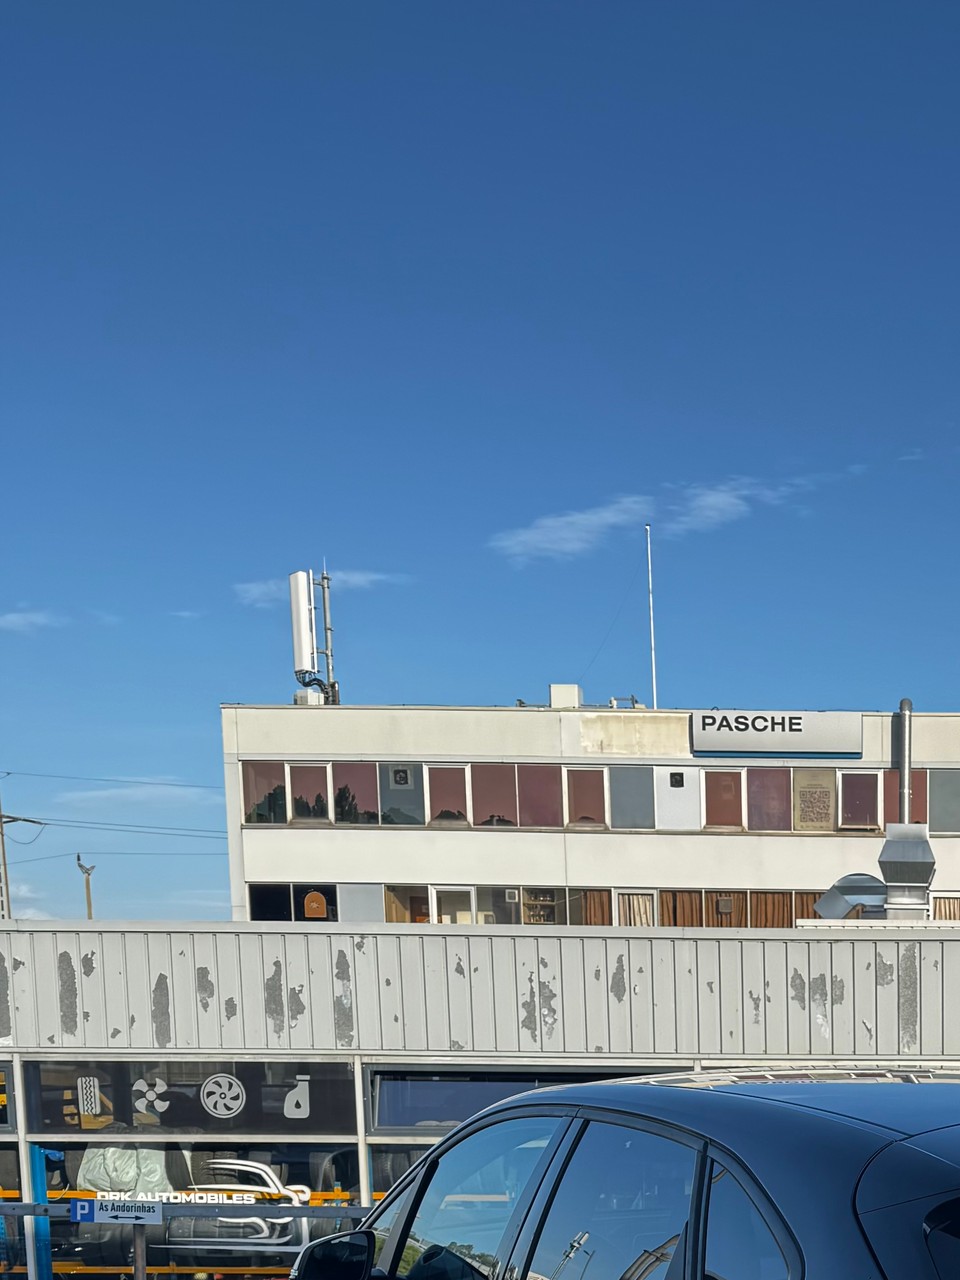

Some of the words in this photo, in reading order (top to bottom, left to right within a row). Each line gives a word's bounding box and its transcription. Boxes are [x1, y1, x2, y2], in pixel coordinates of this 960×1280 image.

[701, 715, 803, 733] PASCHE
[136, 1192, 256, 1204] AUTOMOBILES
[76, 1201, 89, 1221] P
[98, 1202, 109, 1212] As
[111, 1202, 156, 1214] Andorinhas
